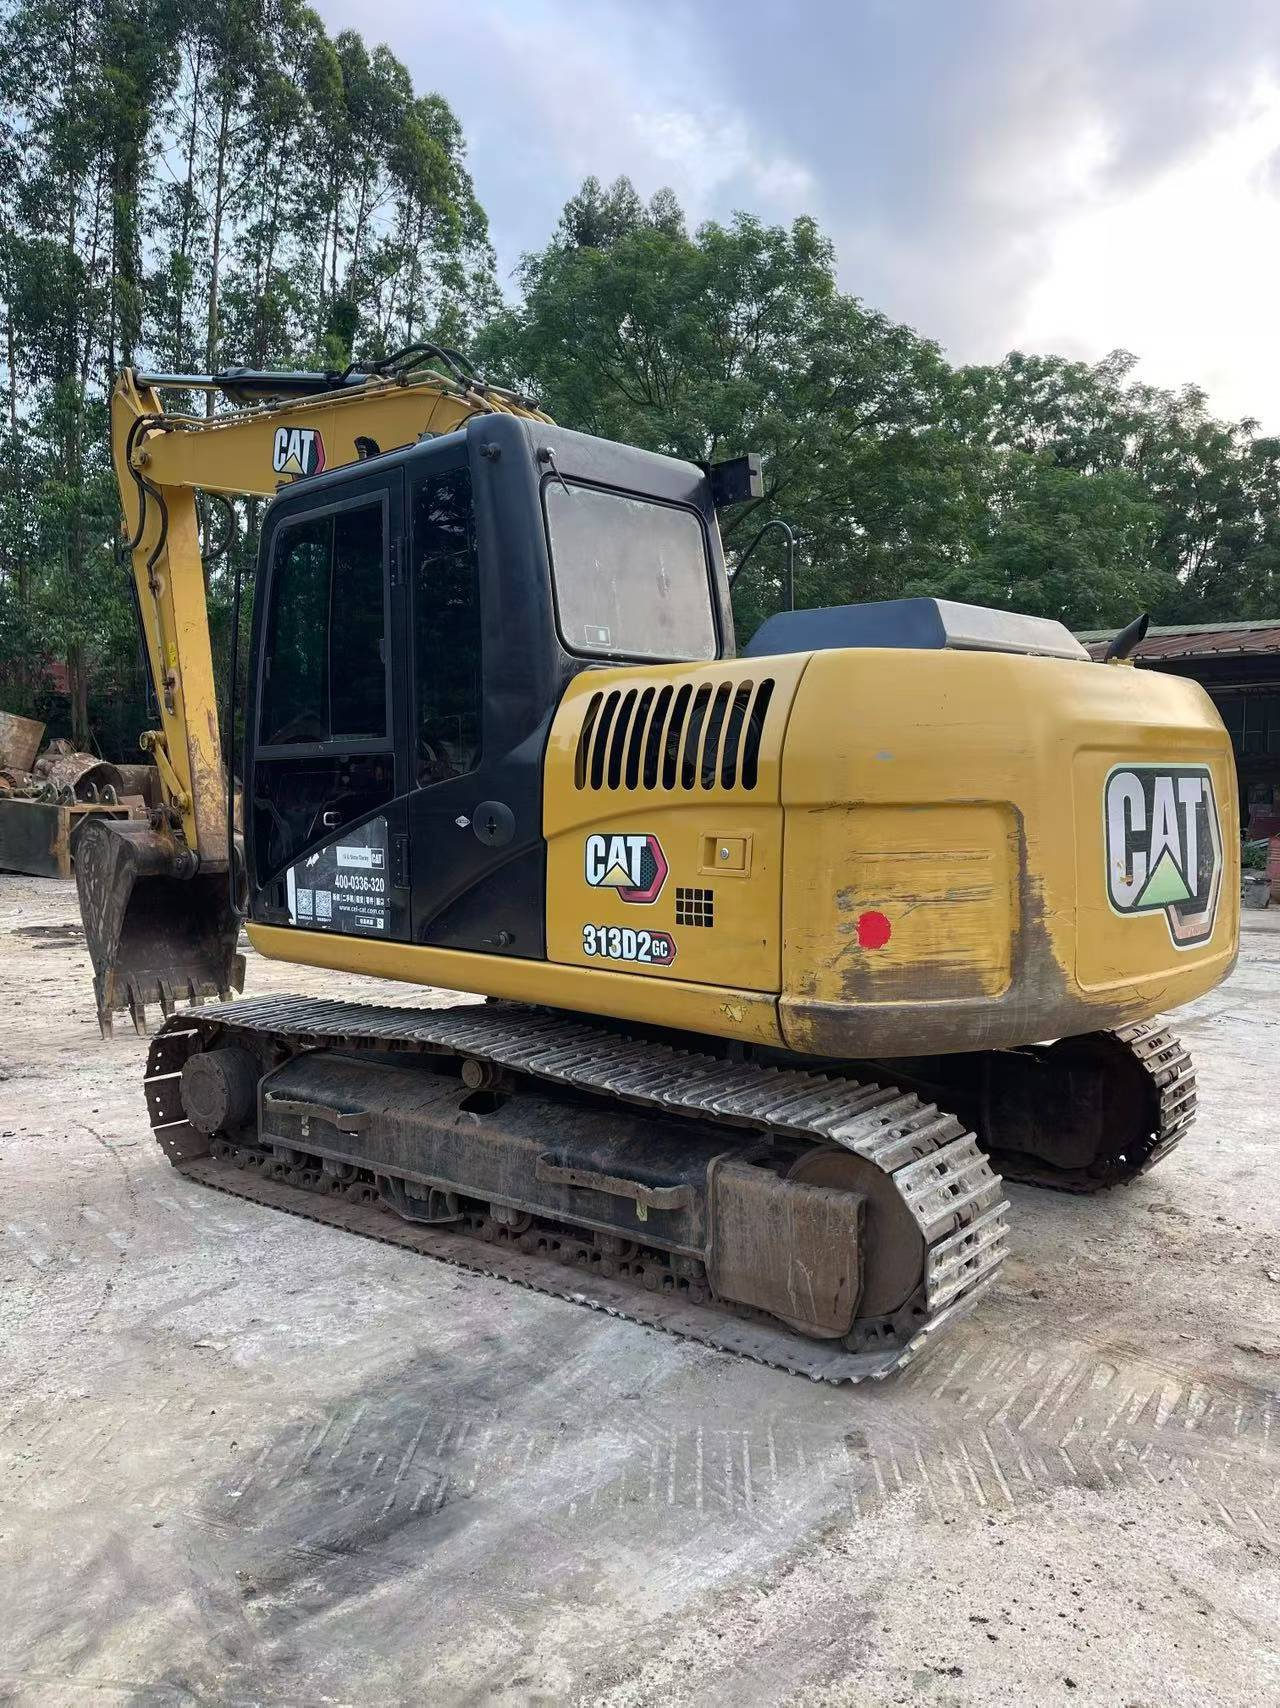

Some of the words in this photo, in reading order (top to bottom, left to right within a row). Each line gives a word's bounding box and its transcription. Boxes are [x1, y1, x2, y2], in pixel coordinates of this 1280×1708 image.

[273, 428, 315, 474] CAT
[586, 835, 647, 887] CAT
[1107, 772, 1202, 907] CAT
[335, 874, 385, 892] 400-0336-320
[583, 925, 652, 962] 313D2
[652, 940, 668, 957] GC
